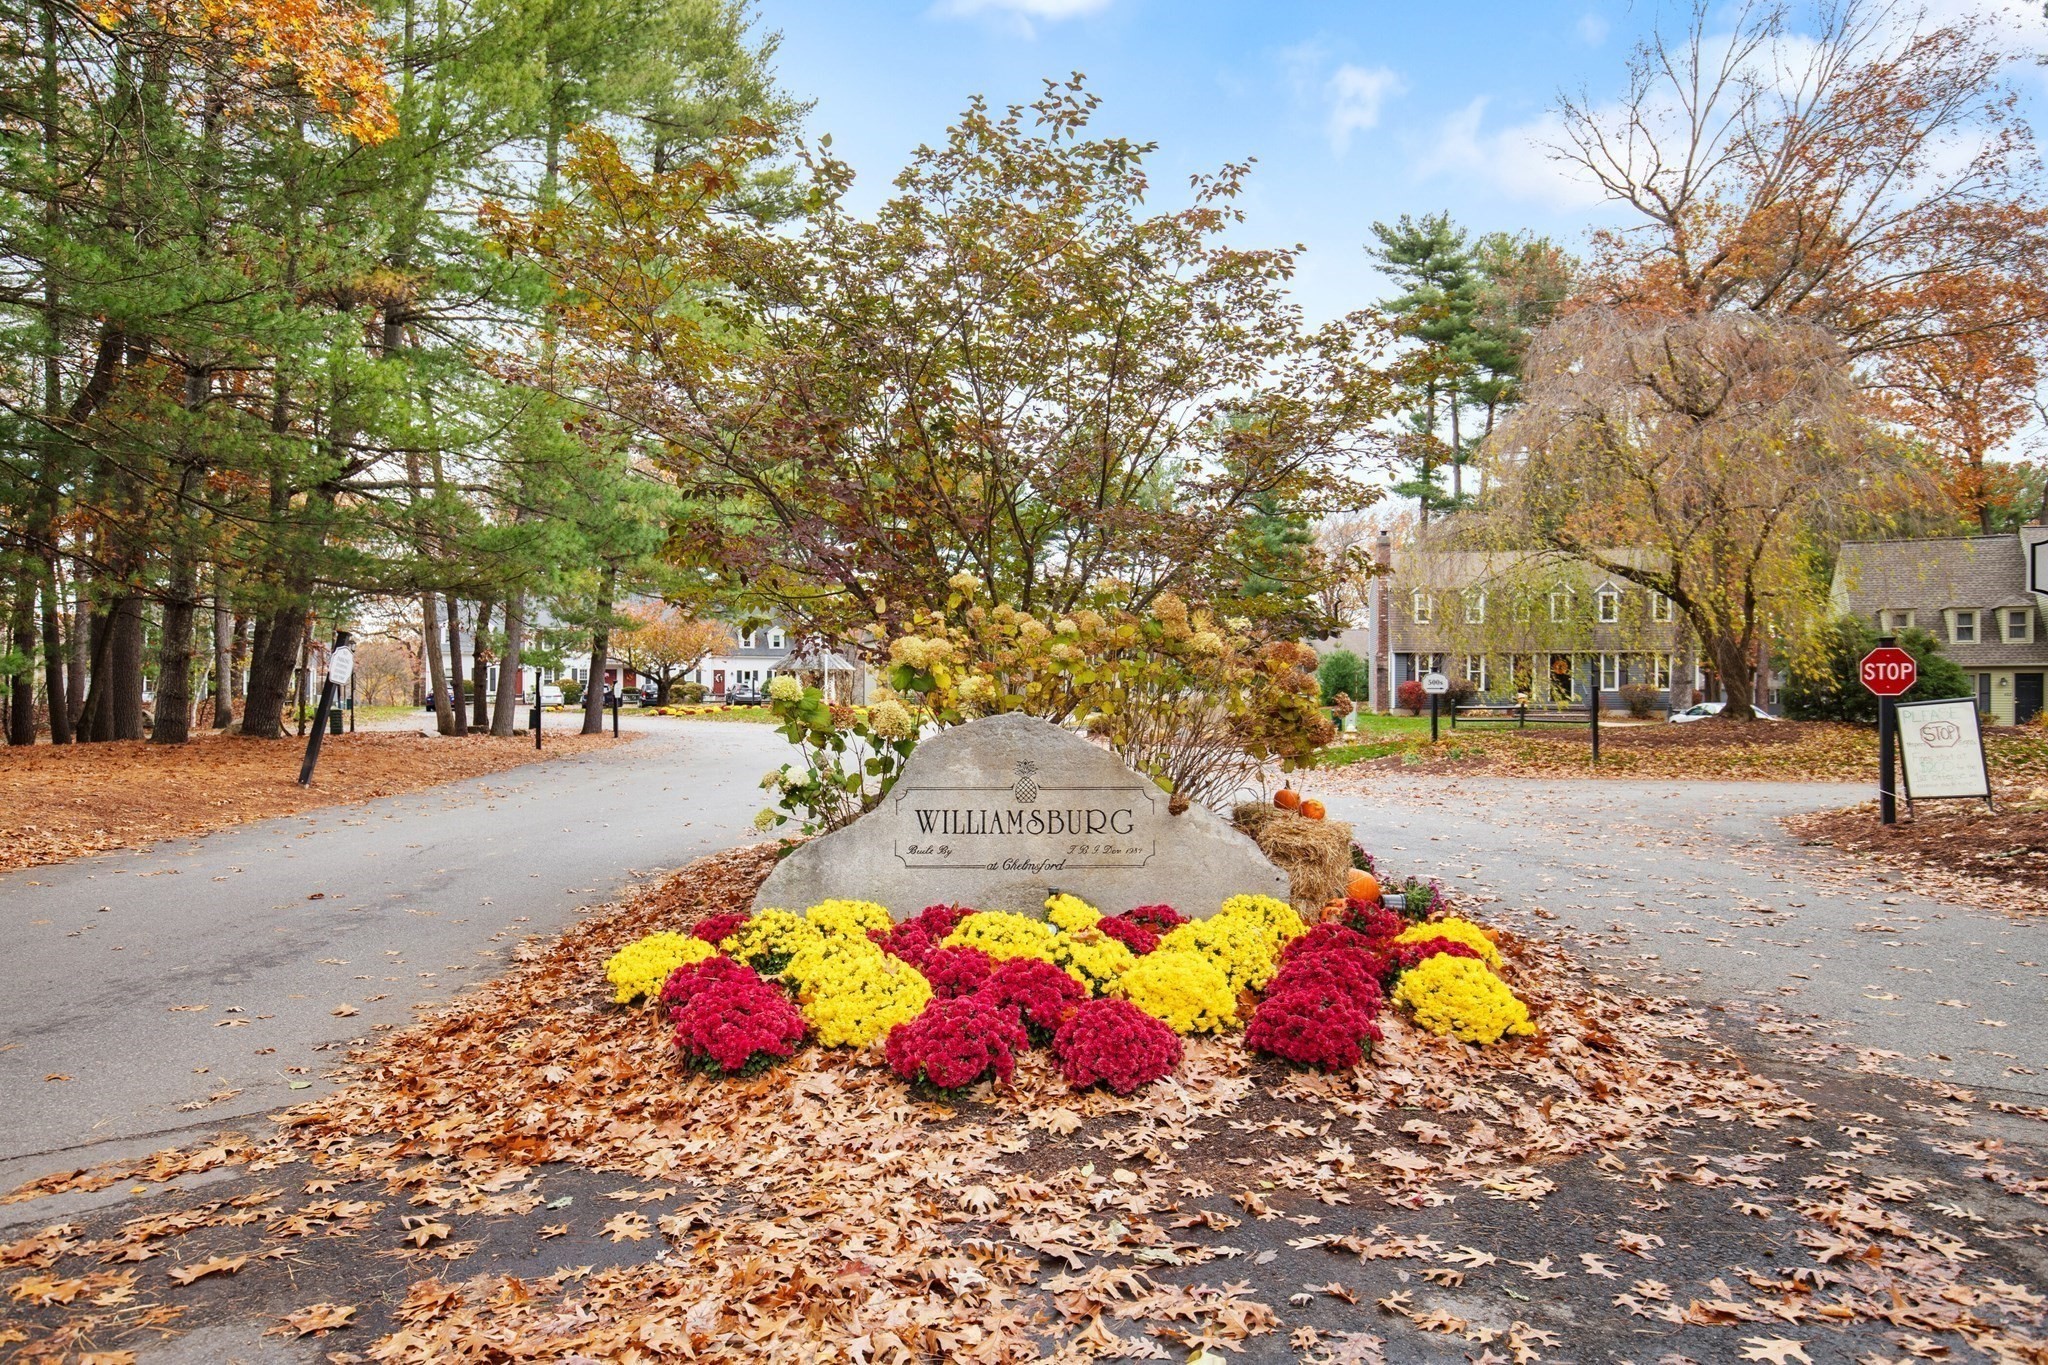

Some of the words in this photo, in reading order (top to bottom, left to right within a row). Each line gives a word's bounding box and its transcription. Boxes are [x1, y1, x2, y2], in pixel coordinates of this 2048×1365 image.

[1864, 662, 1913, 681] STOP
[1902, 706, 1960, 723] PLEASE
[1922, 725, 1956, 742] STOP
[914, 808, 1135, 835] WILLIAMSBURG
[906, 845, 934, 855] Built
[936, 845, 953, 858] By
[1078, 844, 1090, 854] B
[986, 860, 999, 871] at
[1002, 858, 1067, 874] Chelmsford
